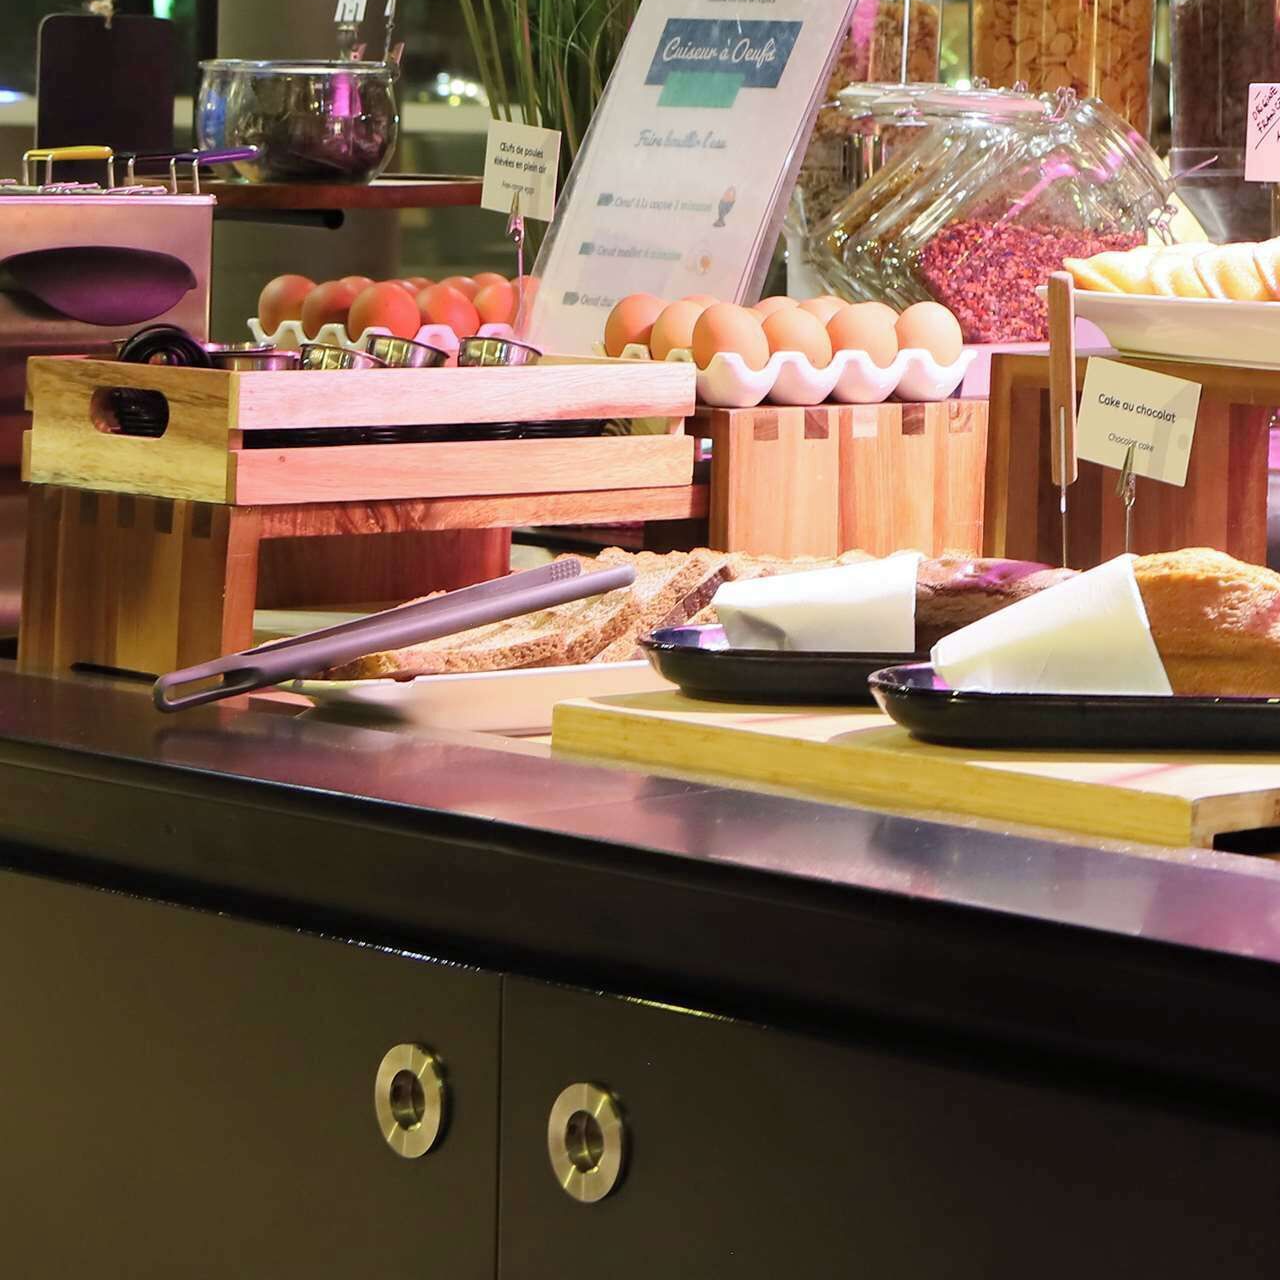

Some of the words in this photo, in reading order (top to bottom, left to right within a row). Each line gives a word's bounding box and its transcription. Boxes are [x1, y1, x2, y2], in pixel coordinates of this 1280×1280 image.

[663, 36, 718, 62] Cuiseur
[718, 37, 731, 61] à
[731, 37, 777, 68] Oeufs
[515, 146, 524, 156] de
[523, 147, 544, 159] poules
[515, 160, 523, 169] en
[523, 160, 538, 172] plein
[538, 163, 547, 174] air
[1098, 393, 1121, 409] Cake
[1122, 400, 1135, 412] au
[1135, 404, 1177, 423] chocolat
